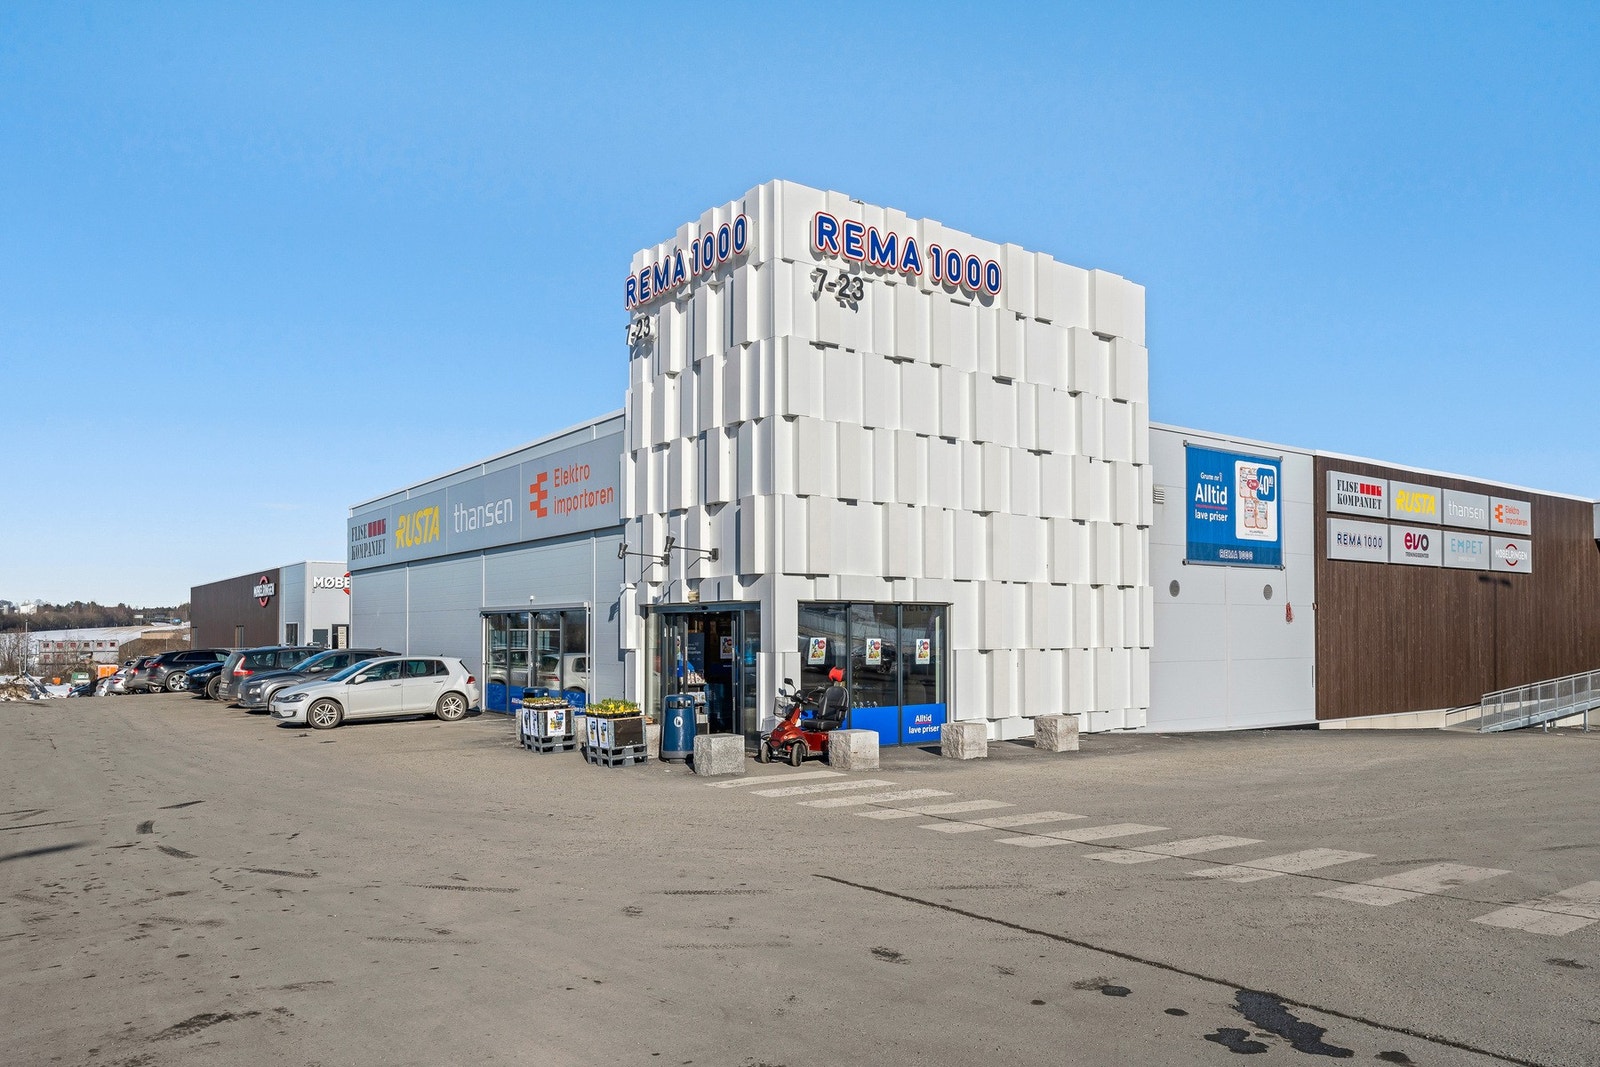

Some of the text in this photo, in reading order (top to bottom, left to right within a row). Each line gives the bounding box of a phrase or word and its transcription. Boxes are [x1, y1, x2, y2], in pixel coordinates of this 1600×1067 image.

[625, 214, 748, 311] REMA 1000
[815, 211, 1002, 295] REMA 1000
[813, 267, 864, 301] 7-23
[625, 315, 652, 346] 7-23
[554, 464, 590, 488] Elektro
[1337, 479, 1359, 494] FLISE
[554, 487, 614, 516] importøren
[1195, 482, 1228, 505] Alltid
[1337, 493, 1382, 510] KOMPANIET
[1396, 489, 1436, 516] RUSTA
[453, 498, 513, 533] thansen
[1195, 509, 1228, 522] lave priser
[1448, 500, 1485, 520] thansen
[351, 523, 367, 542] FLISE
[395, 505, 440, 549] RUSTA
[351, 539, 386, 561] KOMPANIET
[1337, 533, 1382, 549] REMA 1000
[1404, 532, 1429, 551] evo
[1450, 538, 1483, 555] EMPET
[313, 576, 350, 589] MØBE
[915, 714, 932, 723] Alltid
[908, 725, 940, 735] lave priser
